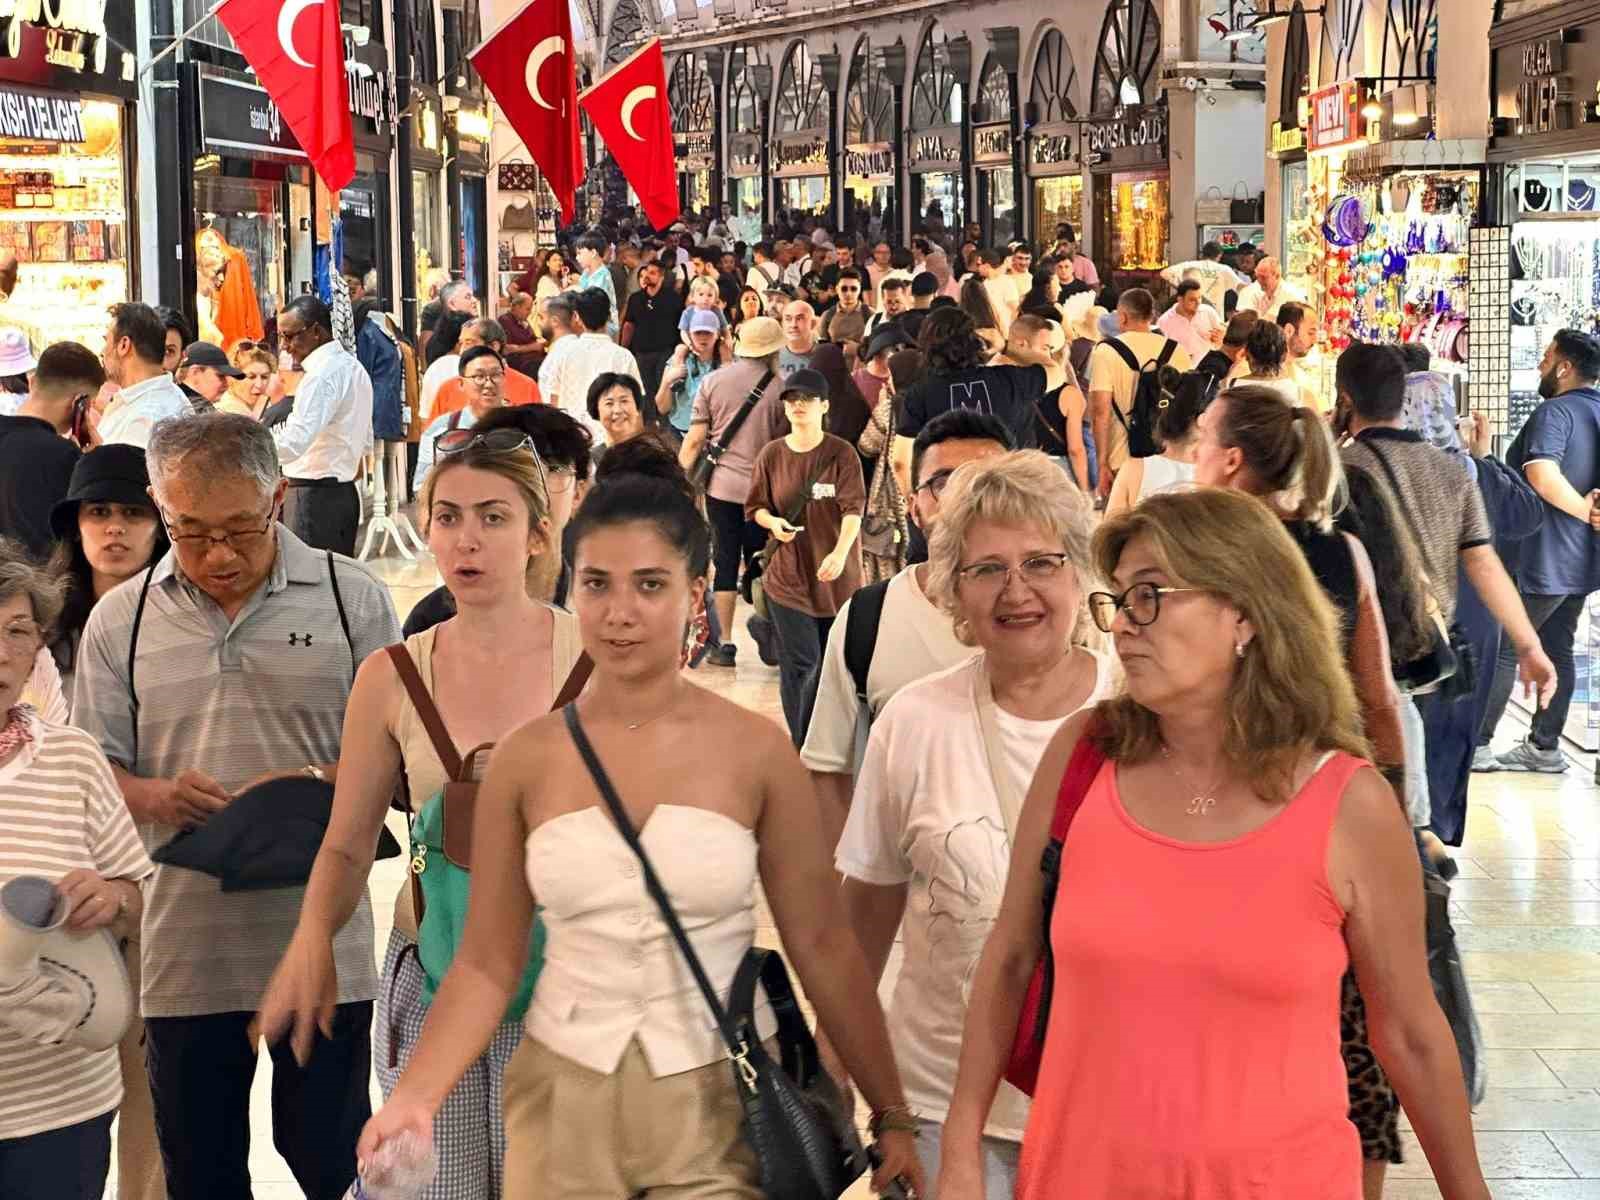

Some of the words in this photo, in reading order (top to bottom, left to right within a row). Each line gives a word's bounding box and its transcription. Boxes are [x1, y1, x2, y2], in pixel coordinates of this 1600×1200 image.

[27, 95, 86, 143] DELIGHT
[269, 99, 280, 142] 34
[1091, 123, 1126, 150] BORSA
[1130, 119, 1161, 146] GOLD
[950, 380, 992, 416] M
